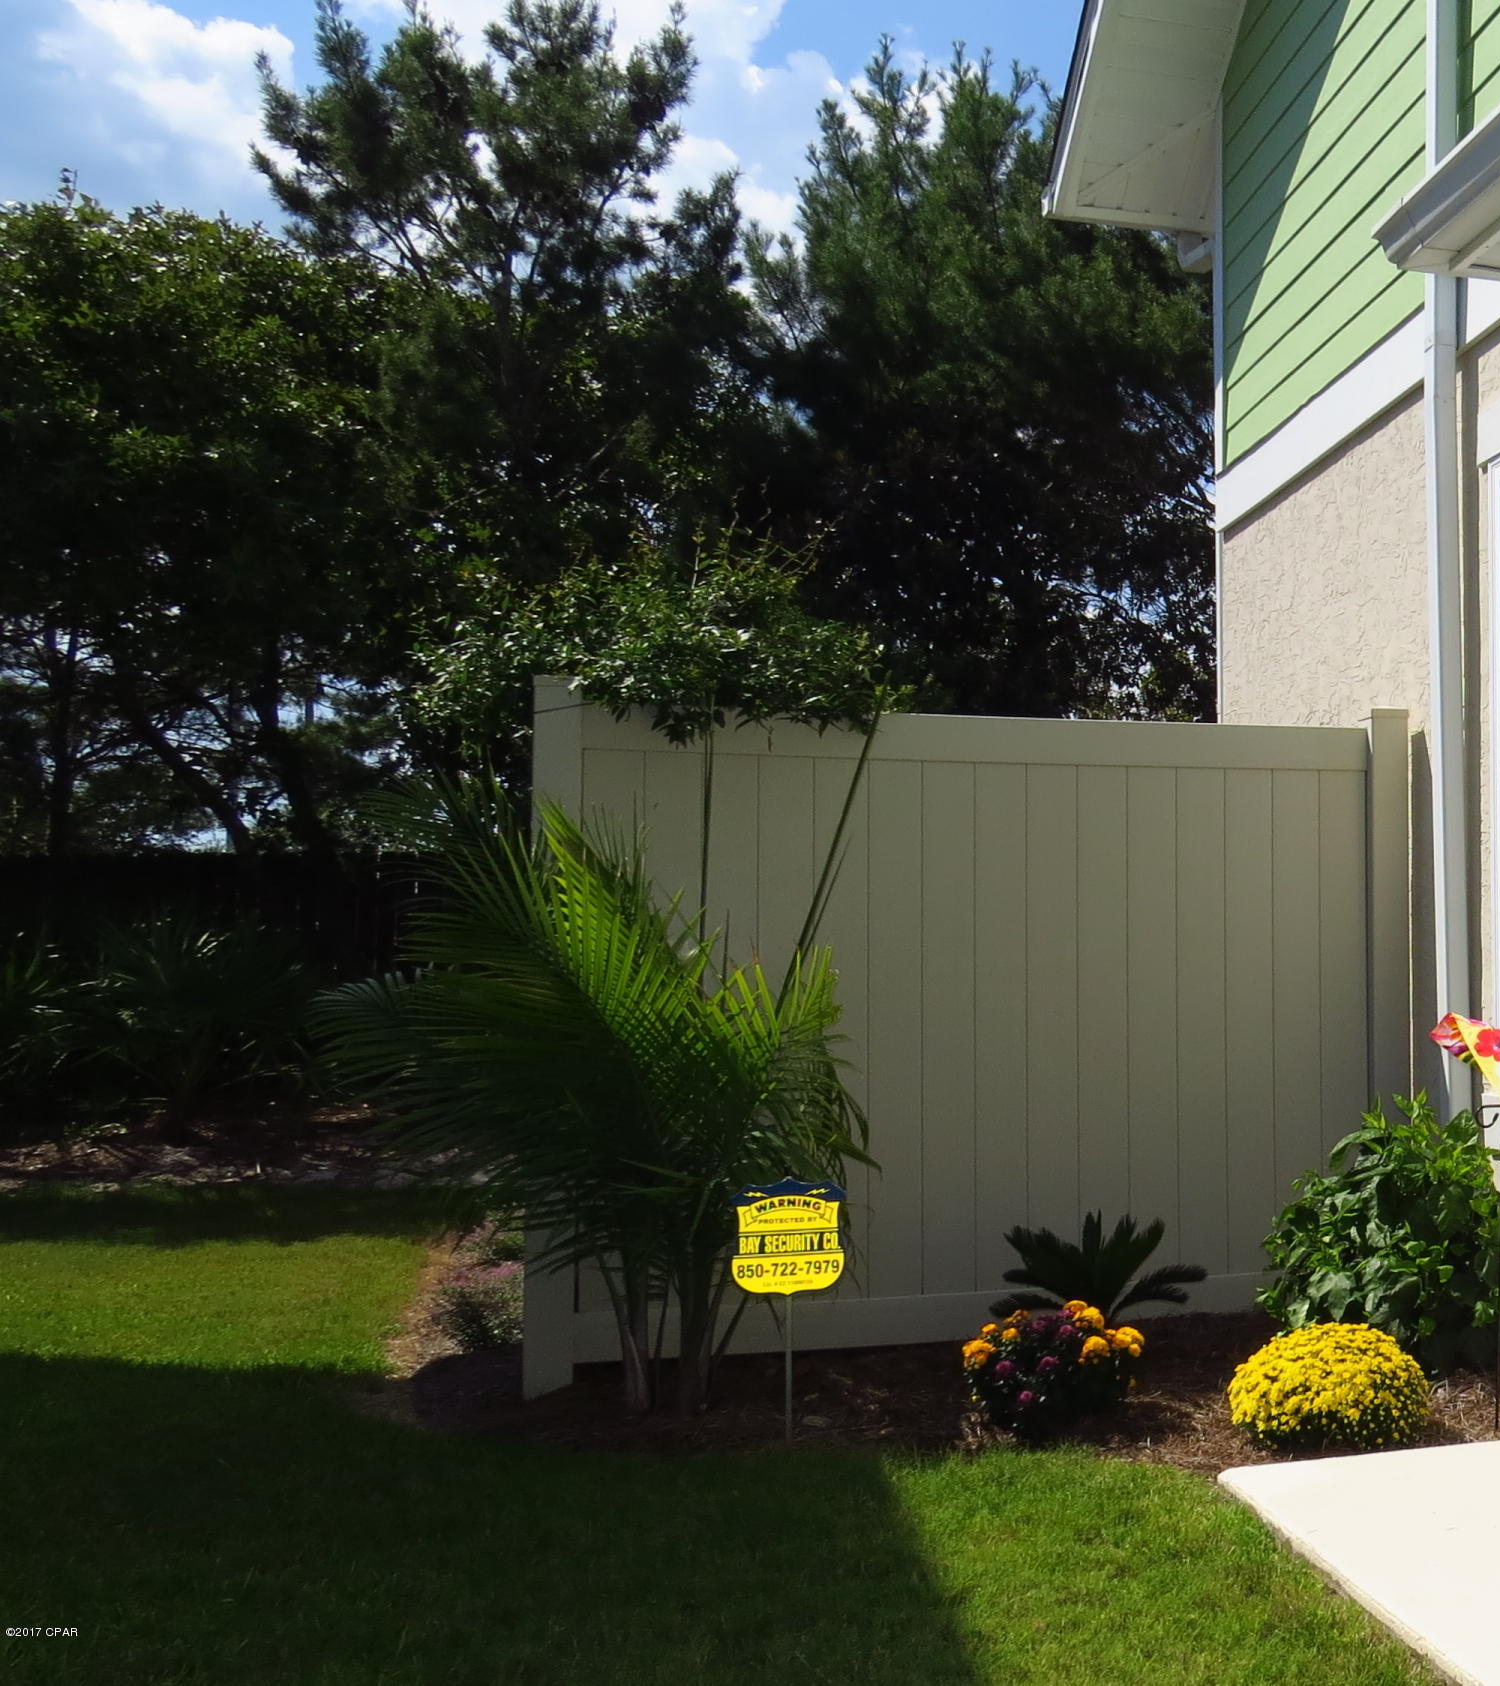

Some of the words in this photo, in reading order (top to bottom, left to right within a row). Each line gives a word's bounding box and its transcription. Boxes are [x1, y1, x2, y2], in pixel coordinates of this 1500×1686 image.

[755, 1198, 822, 1213] WARNING
[758, 1217, 805, 1225] PROTECTED
[739, 1236, 761, 1255] BAY
[764, 1233, 820, 1254] SECURITY
[737, 1259, 840, 1279] 850-722-7979
